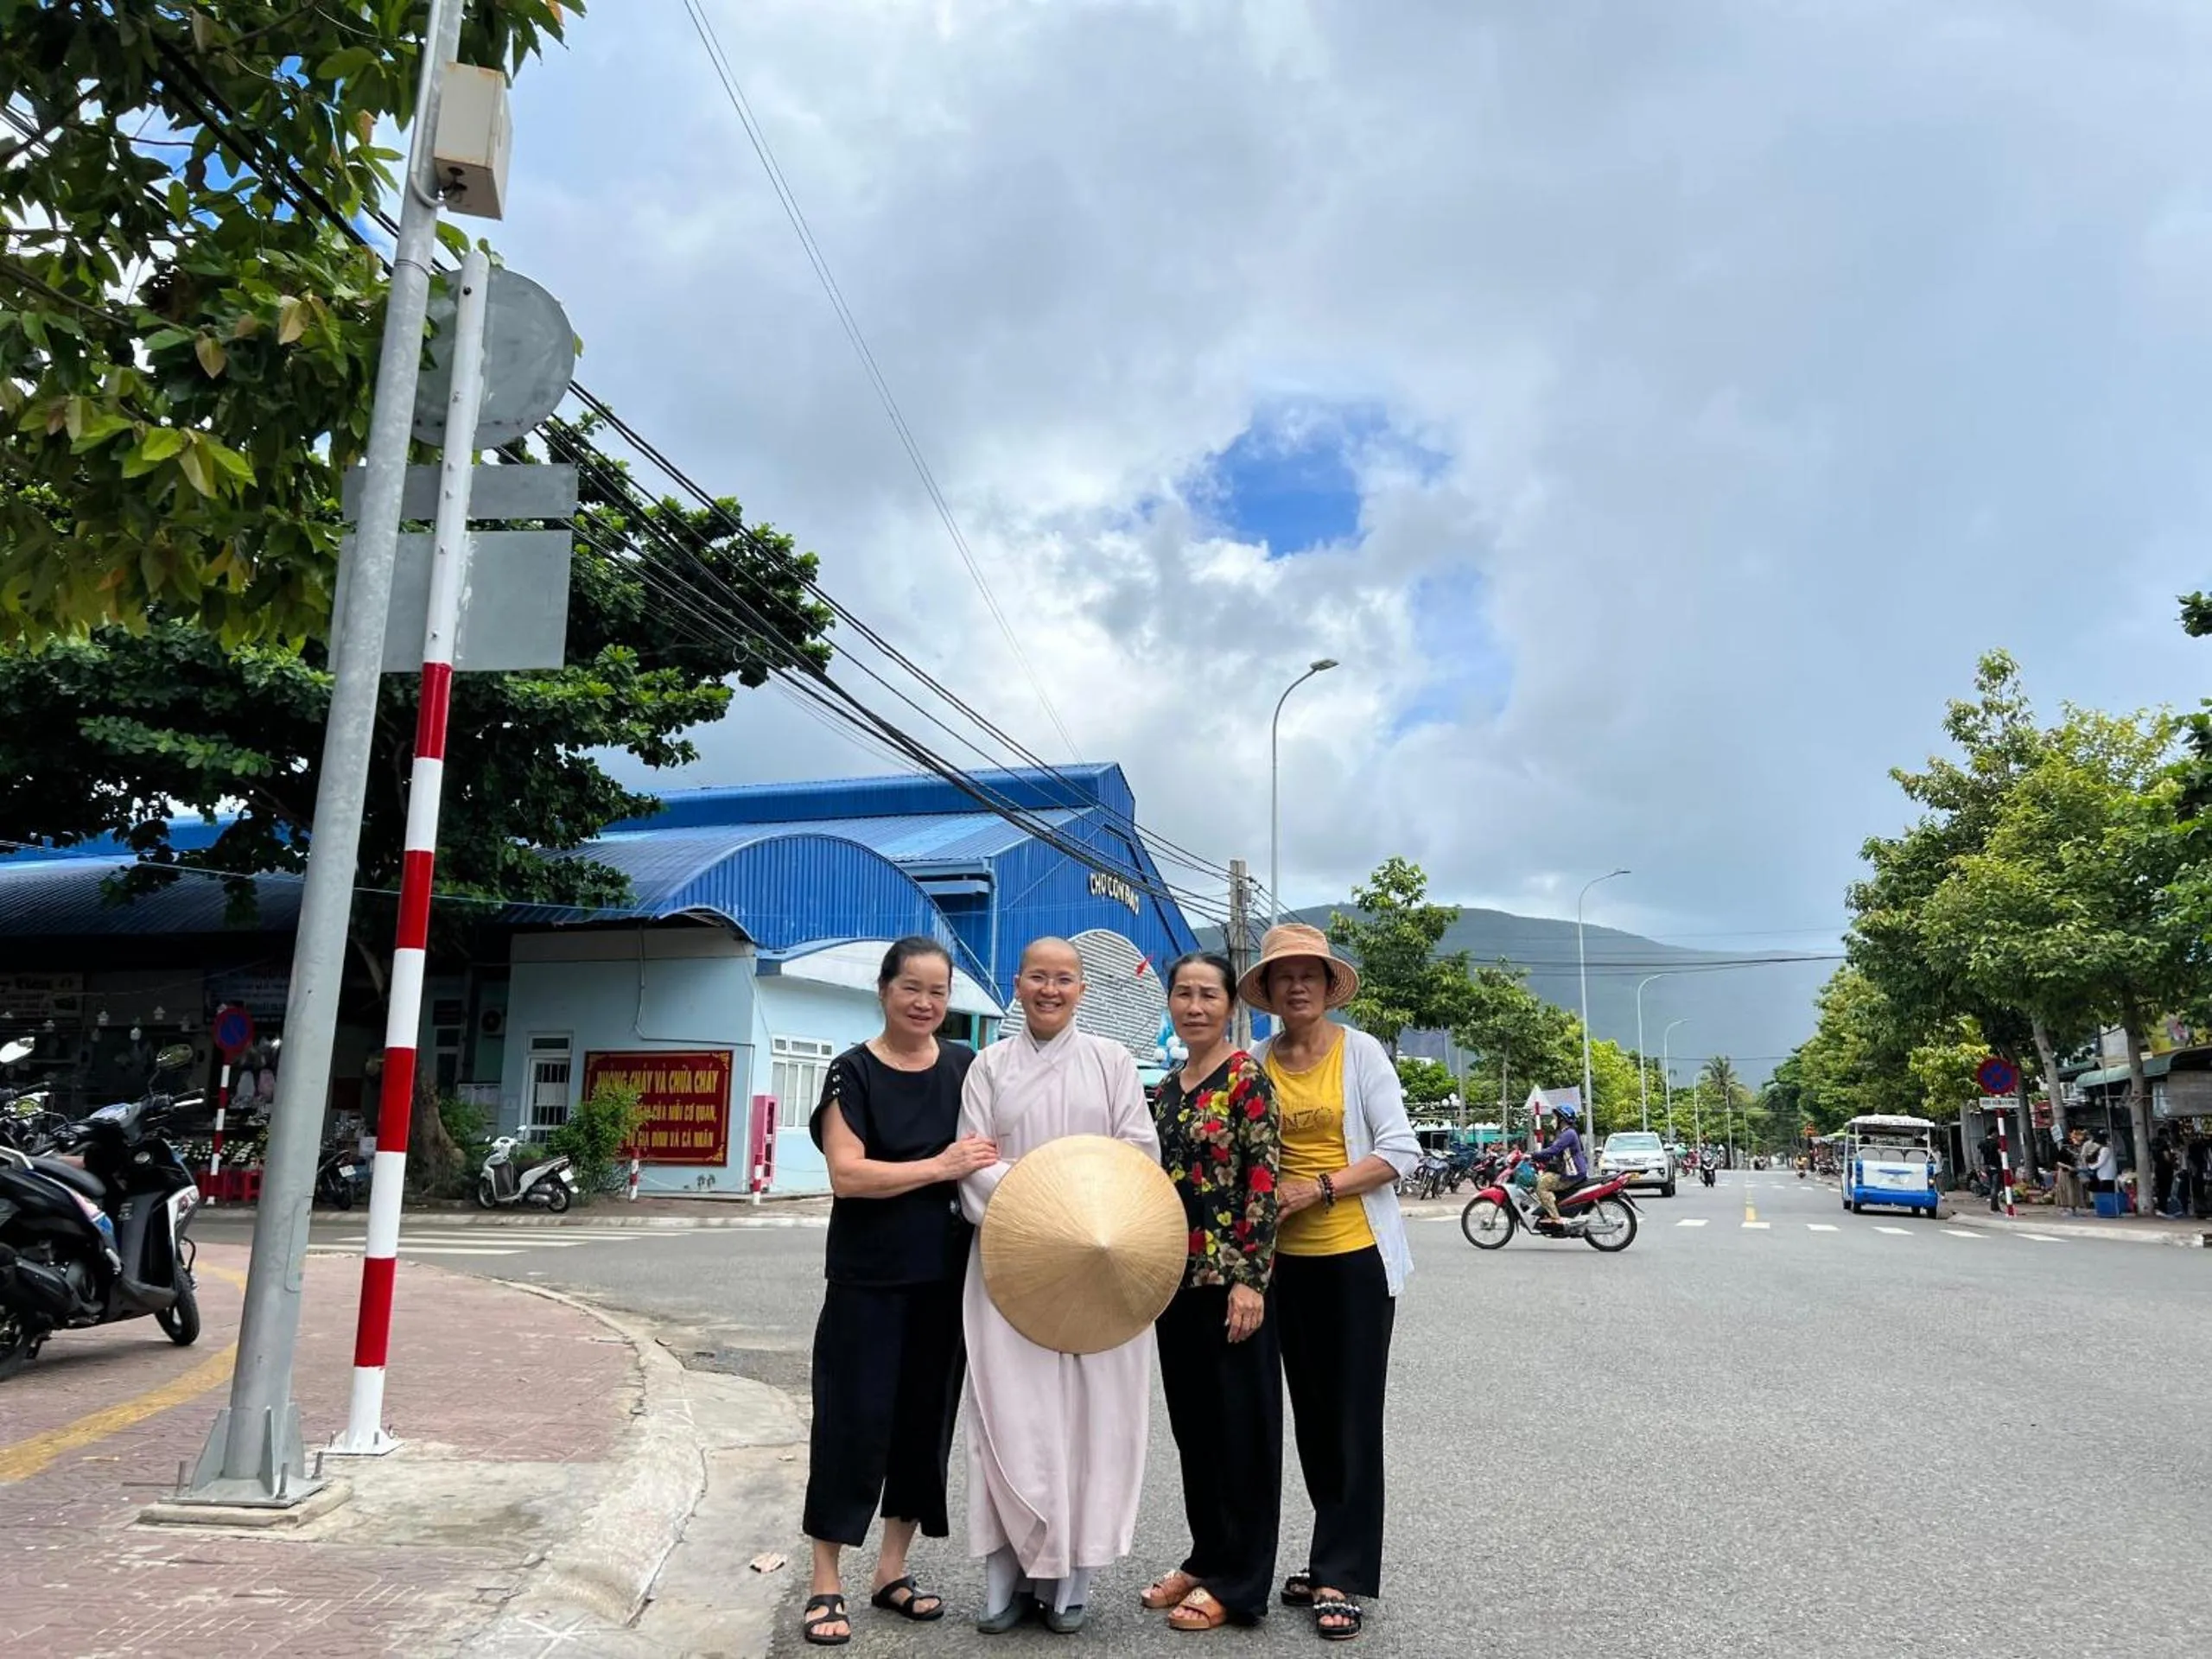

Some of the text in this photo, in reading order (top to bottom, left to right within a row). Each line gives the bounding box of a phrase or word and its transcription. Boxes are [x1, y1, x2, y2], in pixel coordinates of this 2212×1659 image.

[654, 1063, 667, 1093] VÀ
[669, 1064, 692, 1093] CHỮA
[694, 1063, 719, 1093] CHÁY
[670, 1128, 679, 1147] VÀ
[681, 1128, 692, 1147] CÁ
